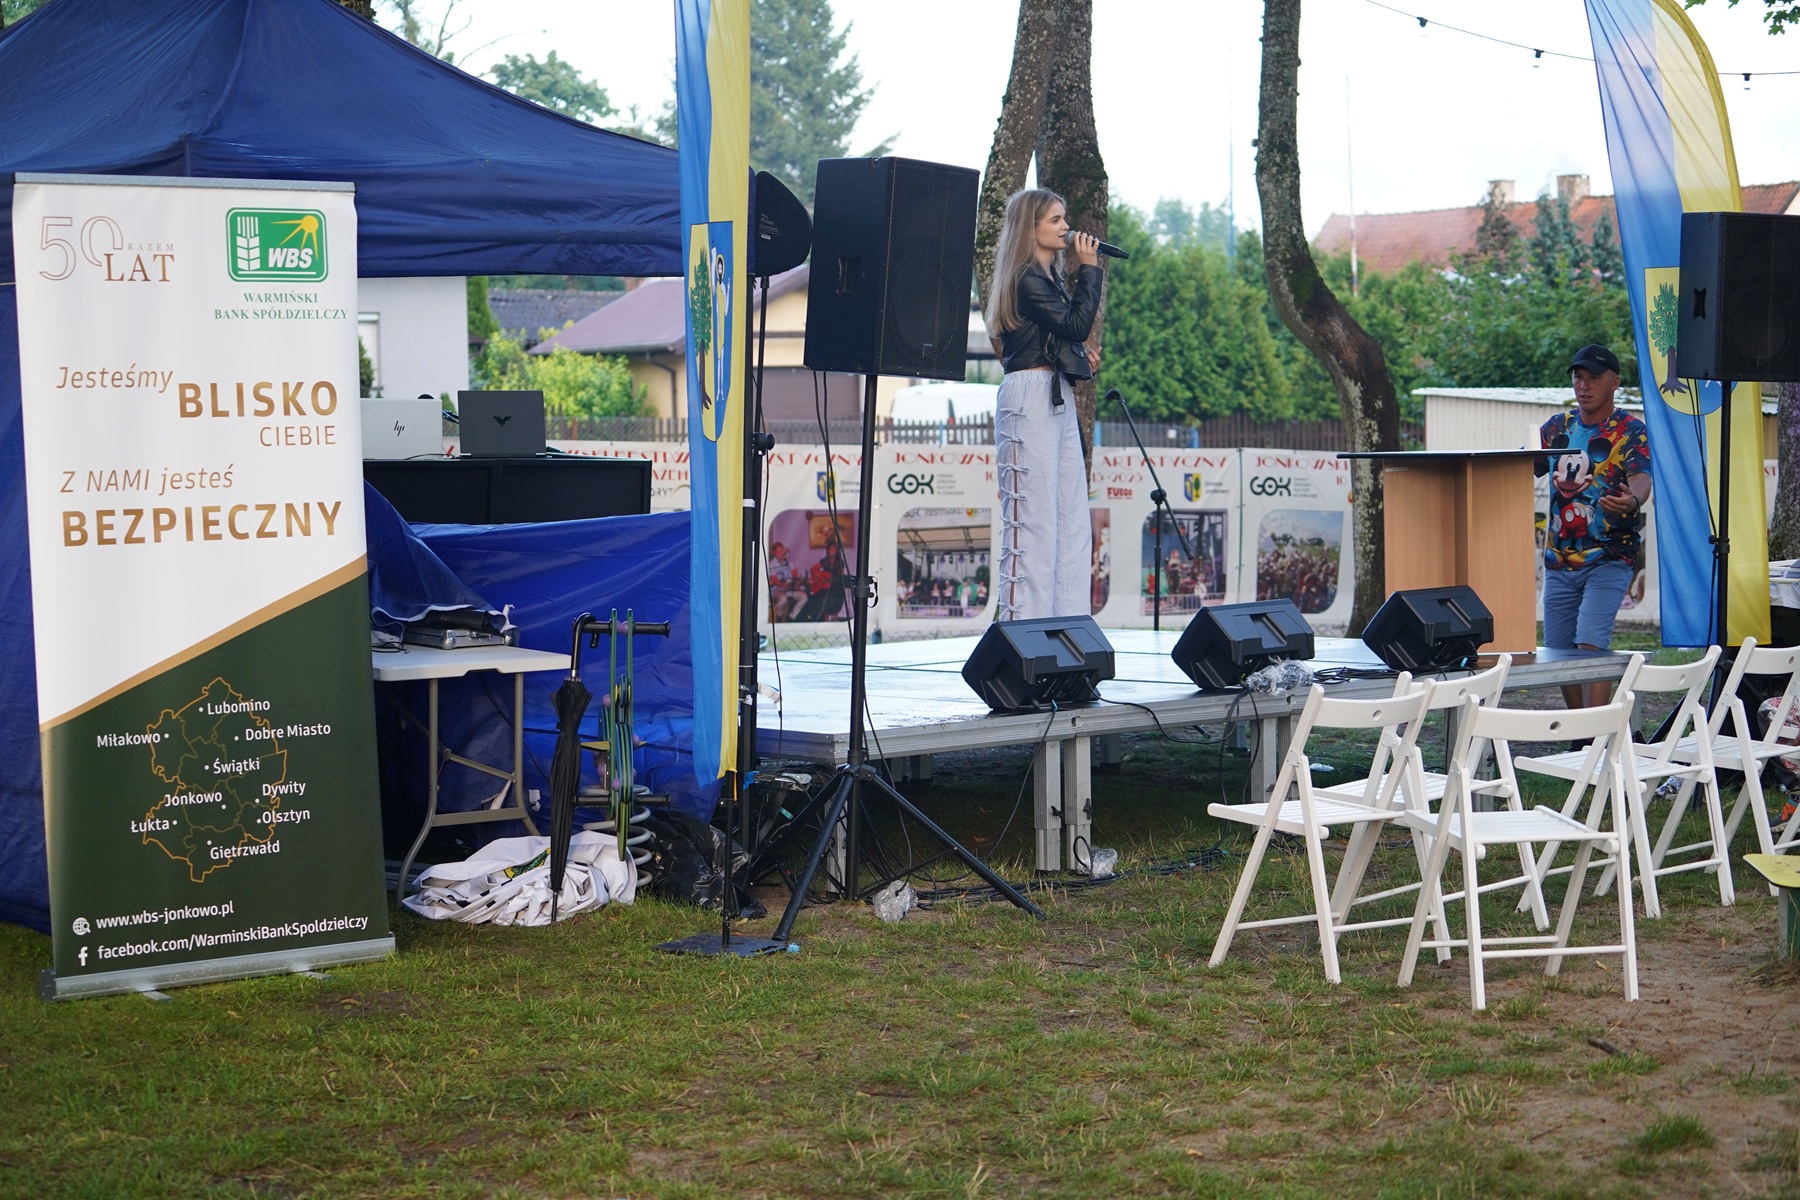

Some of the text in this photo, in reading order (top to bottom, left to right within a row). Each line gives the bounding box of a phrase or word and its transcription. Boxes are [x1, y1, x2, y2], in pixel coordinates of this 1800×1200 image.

[39, 215, 124, 281] 50
[127, 242, 175, 252] RAZEM
[103, 253, 175, 282] LAT
[268, 247, 314, 269] WBS
[243, 290, 319, 304] WARMIŃSKI
[214, 306, 349, 320] BANK SPÓŁDZIELCZY
[56, 363, 174, 395] Jesteśmy
[178, 380, 338, 418] BLISKO
[259, 424, 337, 447] CIEBIE
[393, 420, 405, 436] hp
[1102, 455, 1227, 469] ARTYSTYCZNY
[60, 463, 235, 496] Z NAMI jesteś
[887, 474, 934, 494] GOK
[1250, 476, 1292, 497] GOK
[62, 501, 342, 547] BEZPIECZNY
[207, 699, 271, 715] Lubomino
[97, 732, 161, 748] Miłakowo
[245, 723, 331, 741] Dobre Miasto
[213, 758, 260, 775] Świątki
[164, 790, 222, 807] Jonkowo
[262, 781, 306, 798] Dywity
[131, 818, 170, 834] Łukta
[262, 808, 311, 825] Olsztyn
[210, 840, 280, 860] Gietrzwałd
[96, 901, 235, 929] www.wbs-jonkowo.pl
[97, 916, 369, 959] facebook.com/WarminskiBankSpoldzielczy
